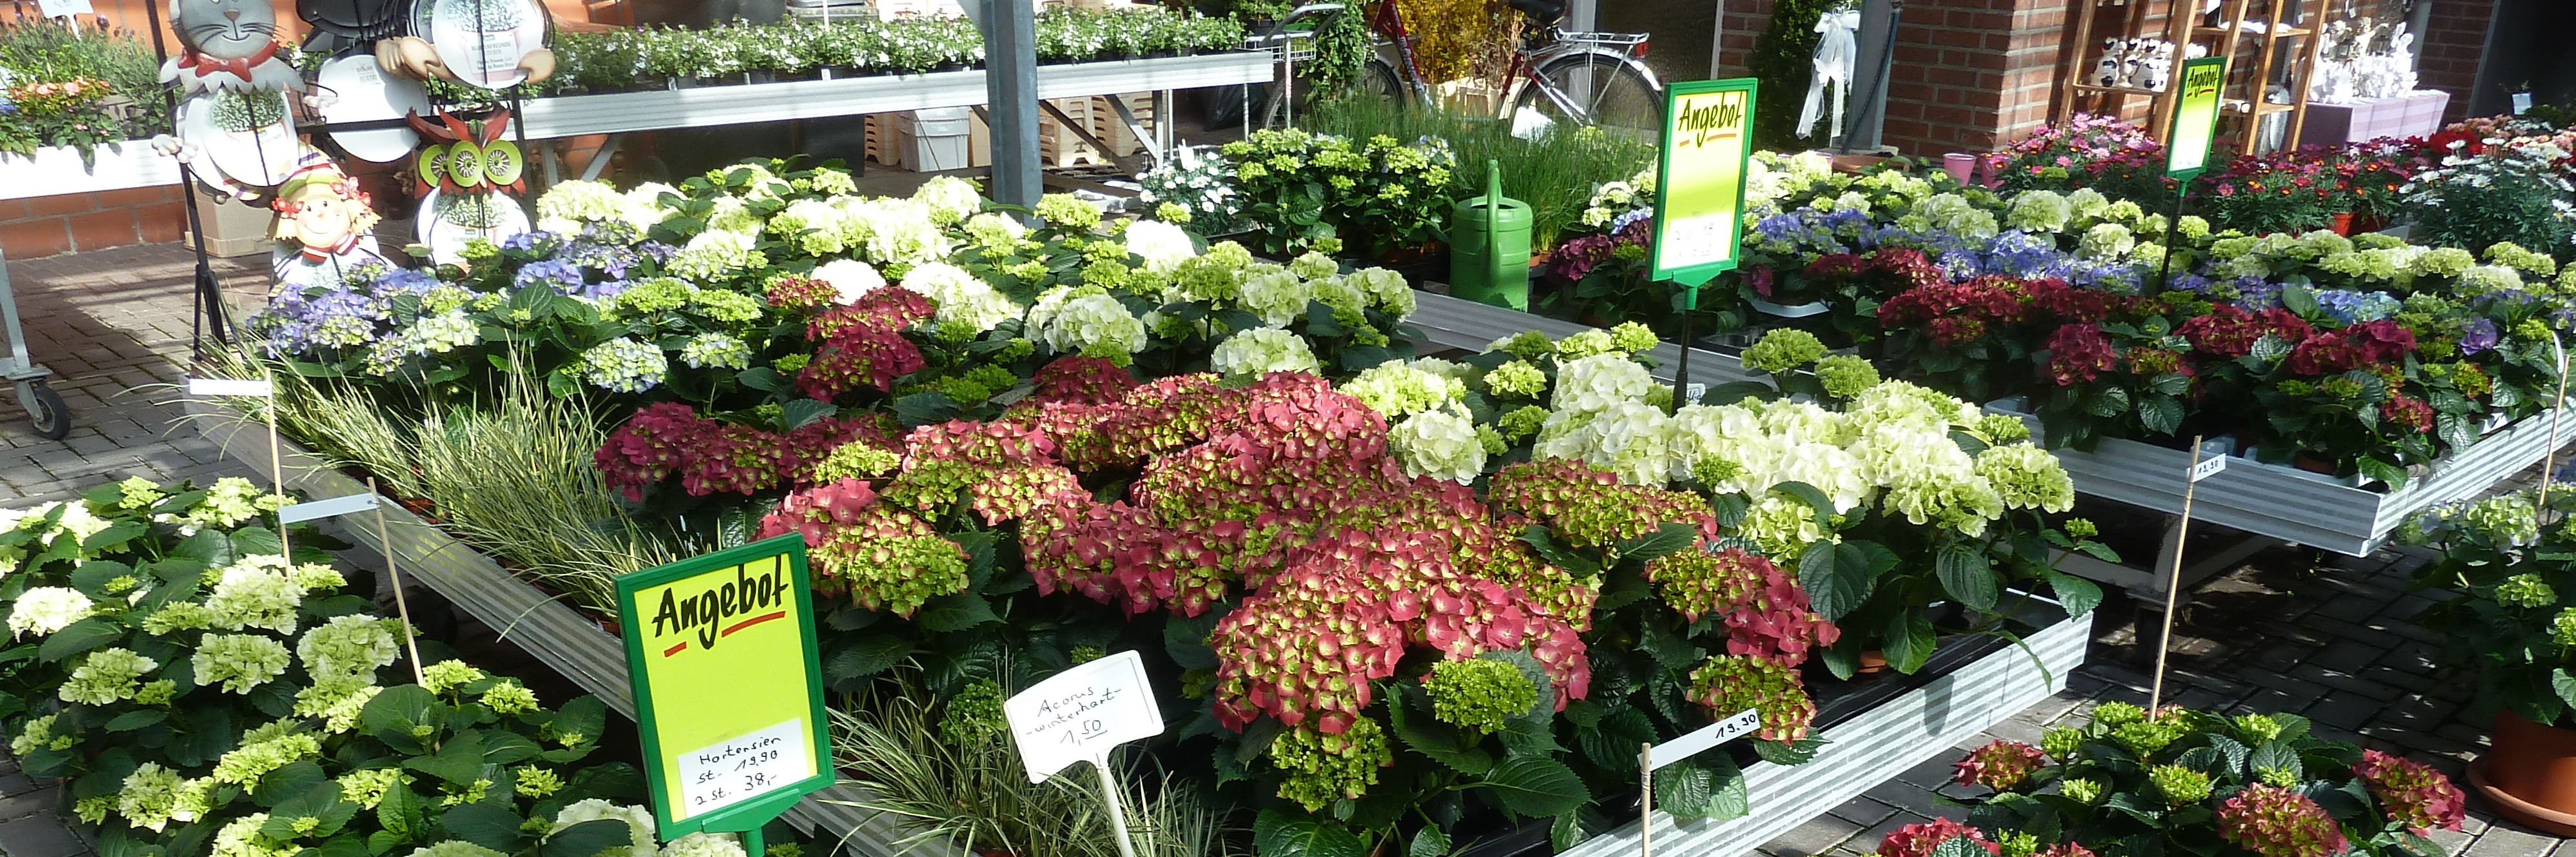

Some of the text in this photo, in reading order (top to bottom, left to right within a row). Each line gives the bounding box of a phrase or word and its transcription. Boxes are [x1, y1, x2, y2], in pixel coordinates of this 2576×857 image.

[2187, 64, 2218, 98] Angebot
[1679, 92, 1742, 148] Angebot
[652, 555, 789, 650] Angebot
[1037, 687, 1093, 717] Acorus
[1060, 720, 1101, 745] 1,50
[699, 736, 781, 765] Hortensien
[695, 796, 707, 805] 2
